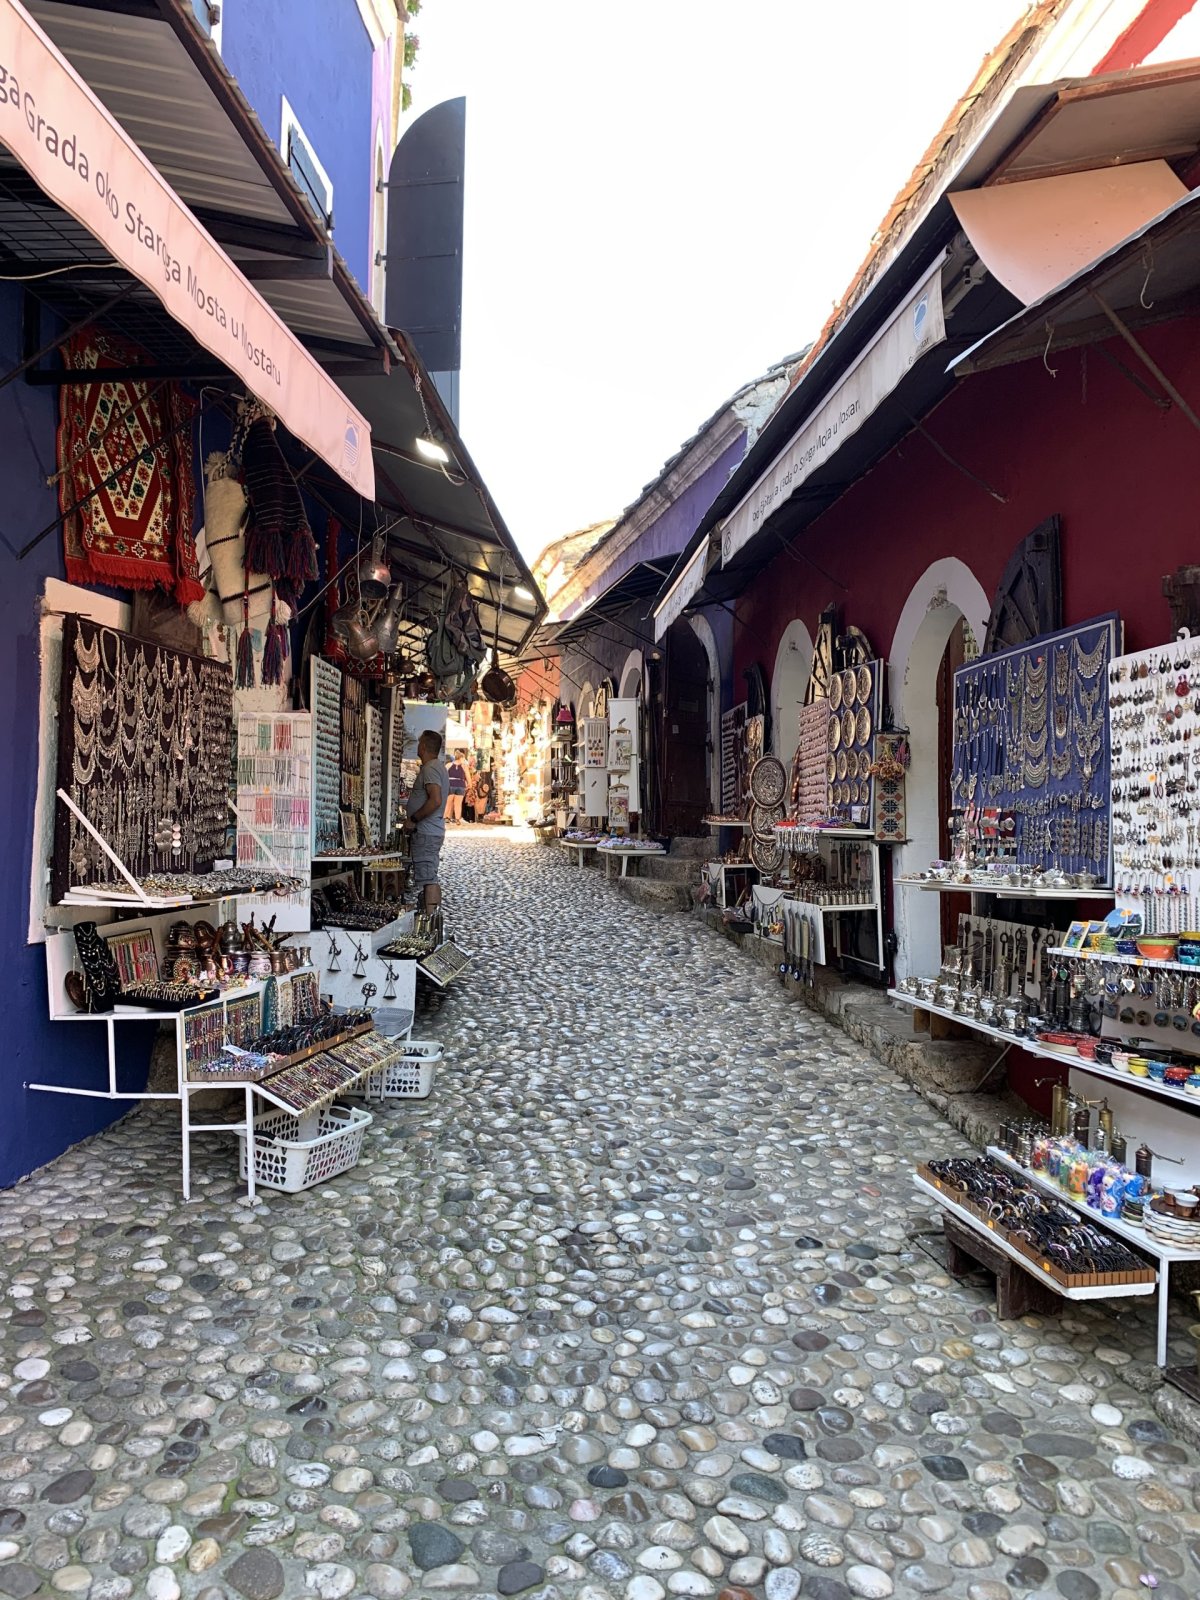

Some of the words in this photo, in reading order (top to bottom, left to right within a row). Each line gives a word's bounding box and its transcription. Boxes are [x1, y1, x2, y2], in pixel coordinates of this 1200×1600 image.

[24, 92, 90, 183] Grada
[95, 171, 120, 220] oko
[187, 265, 227, 330] Mosta
[231, 316, 239, 341] u
